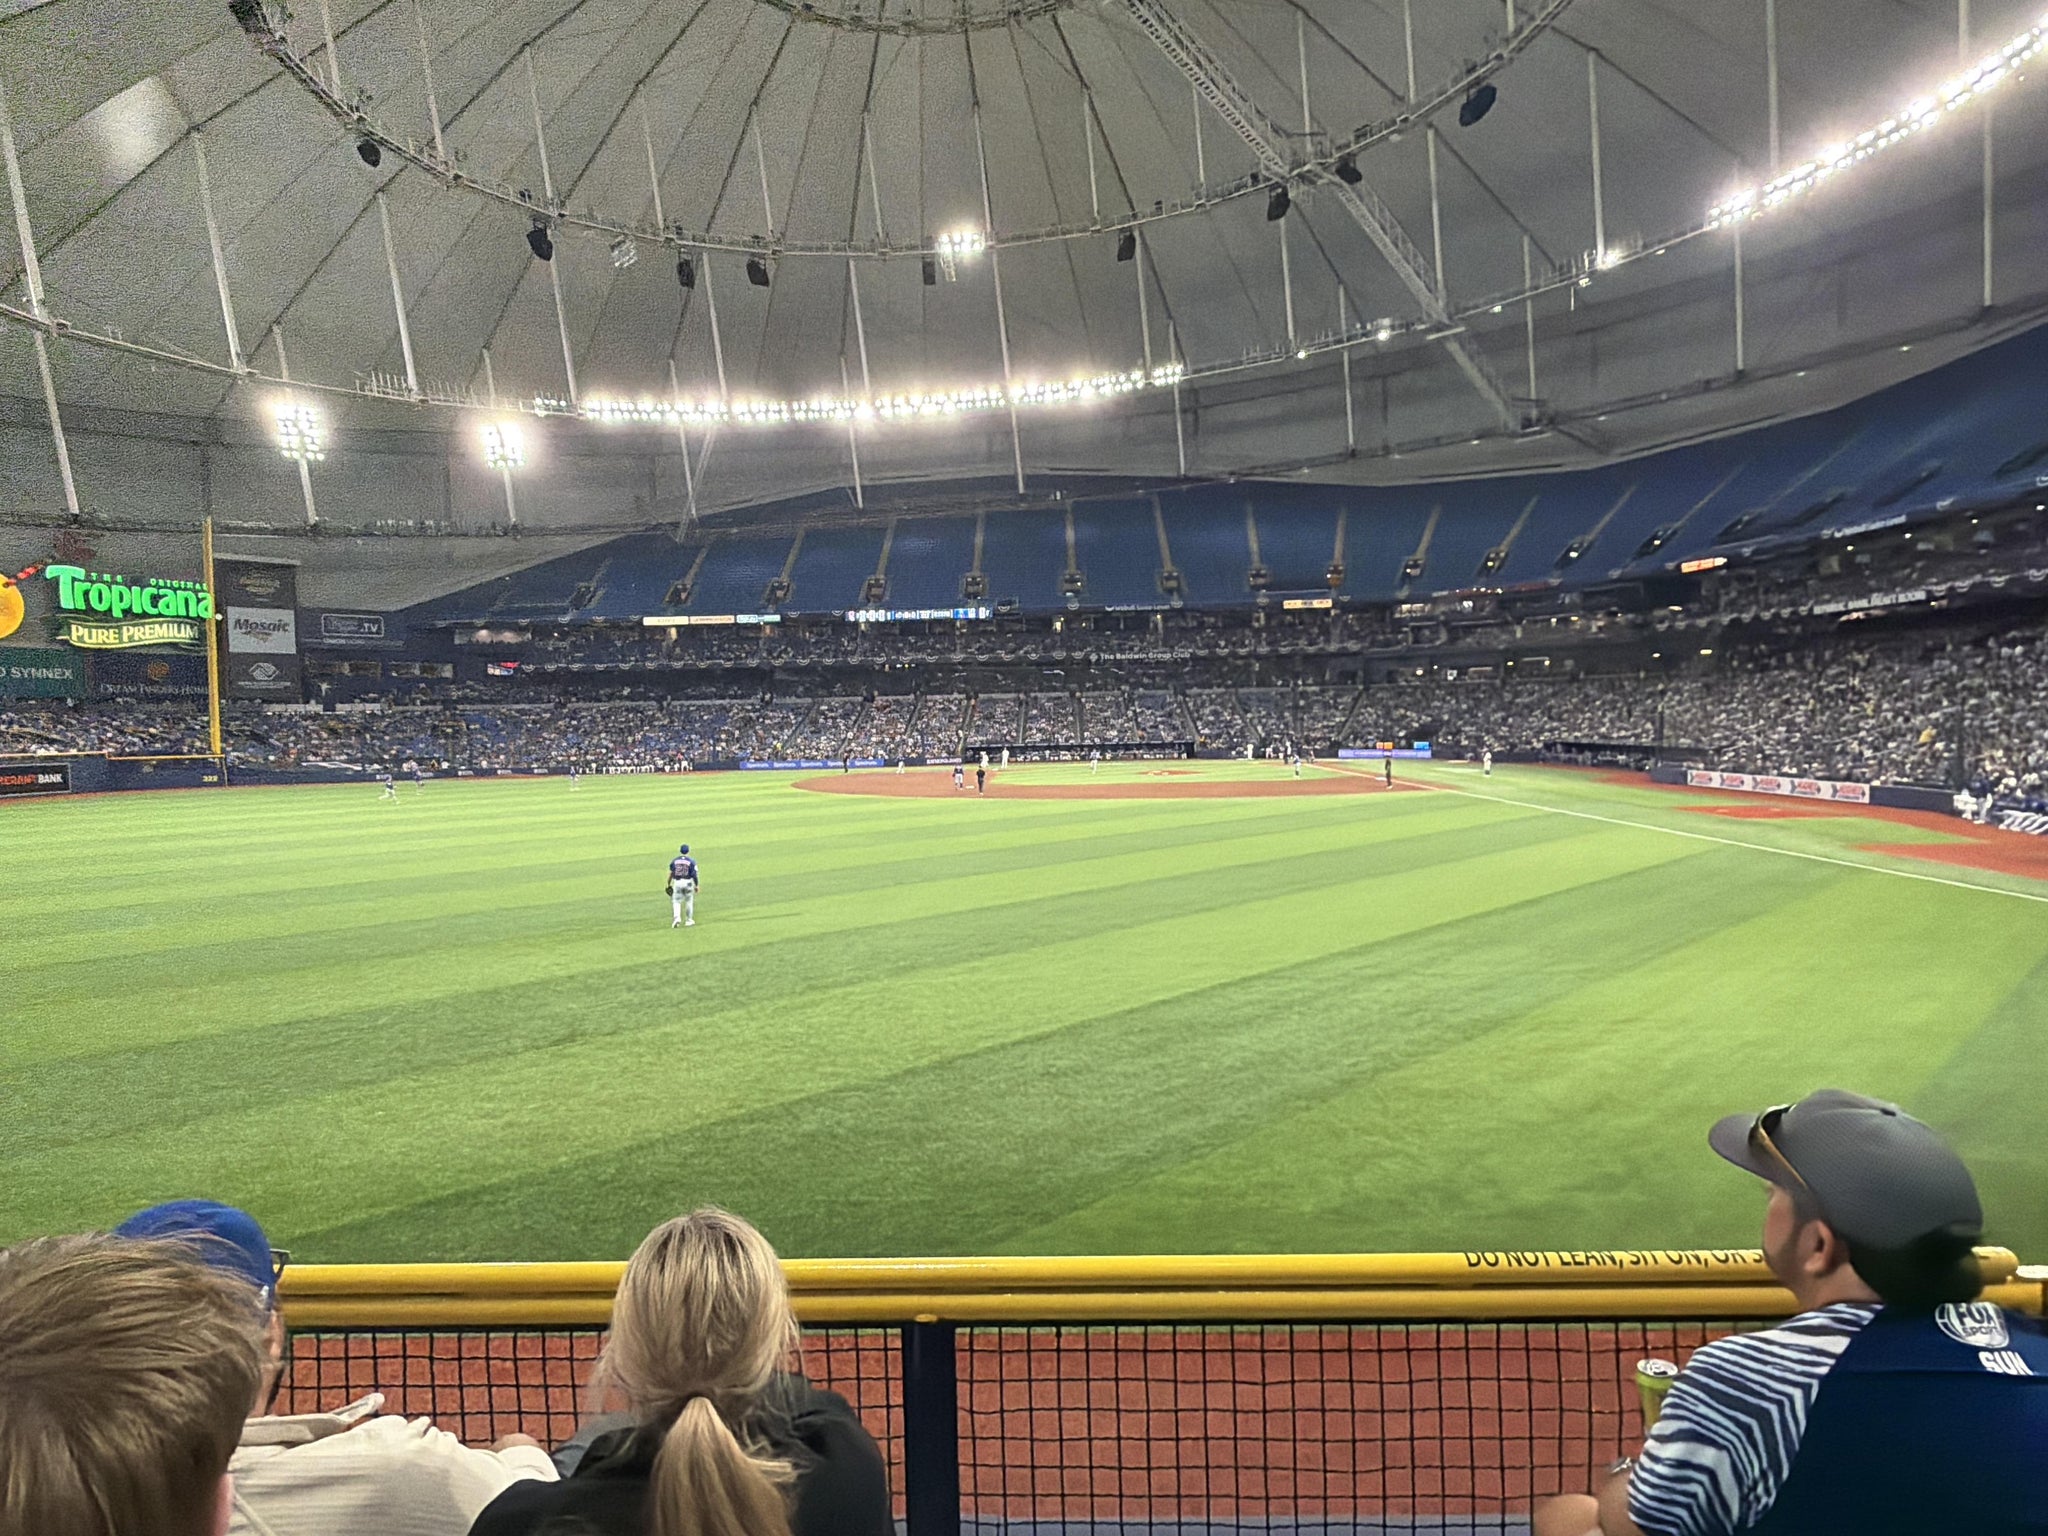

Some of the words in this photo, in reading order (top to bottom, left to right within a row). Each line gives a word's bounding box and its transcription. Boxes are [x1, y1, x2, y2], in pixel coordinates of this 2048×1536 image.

[46, 565, 213, 618] Tropicana
[71, 624, 119, 643] PURE
[122, 623, 199, 642] PREMIUM
[234, 619, 290, 634] Mosaic
[11, 667, 73, 679] SYNNEX
[38, 773, 63, 785] BANK
[1465, 1252, 1499, 1267] DO
[1558, 1252, 1624, 1269] LEAN,
[1665, 1251, 1709, 1268] ON,
[1953, 1303, 1996, 1326] FOX
[1978, 1351, 2034, 1376] SUN
